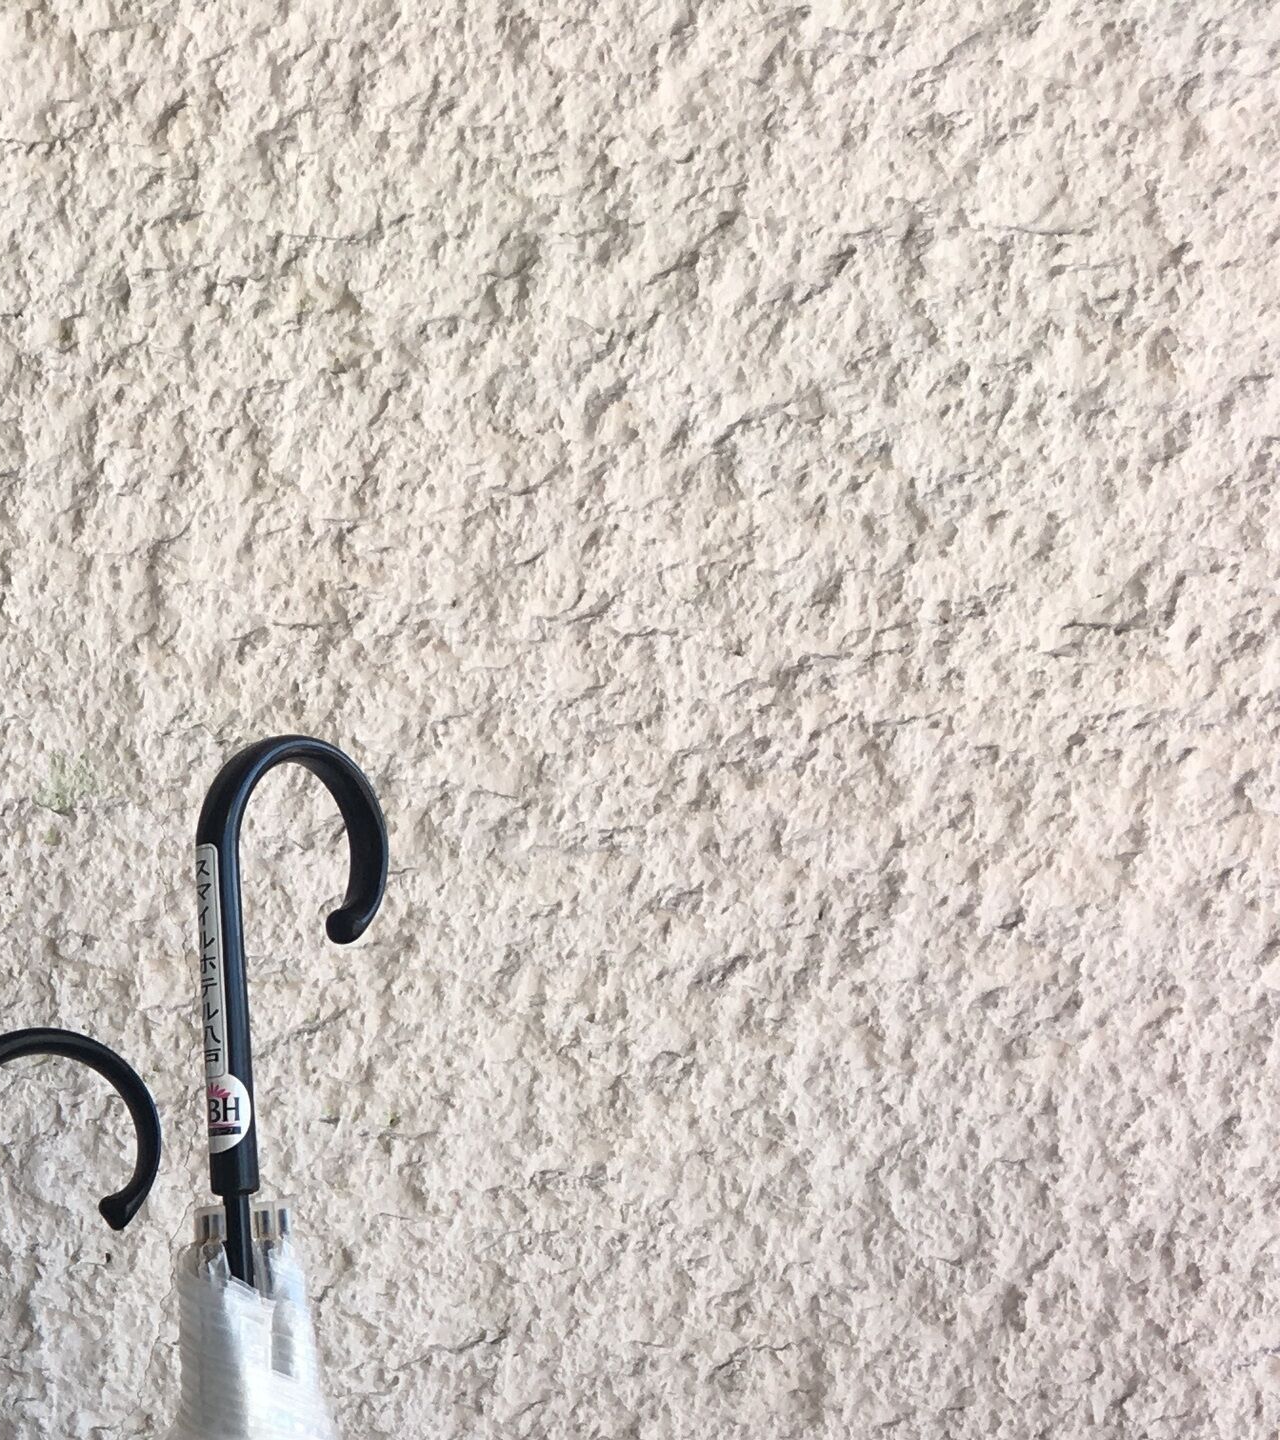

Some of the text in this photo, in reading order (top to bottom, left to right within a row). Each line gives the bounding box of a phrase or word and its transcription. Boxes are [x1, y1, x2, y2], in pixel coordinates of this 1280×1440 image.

[195, 859, 222, 1063] スマイルホテル八戸
[207, 1096, 241, 1123] BH
